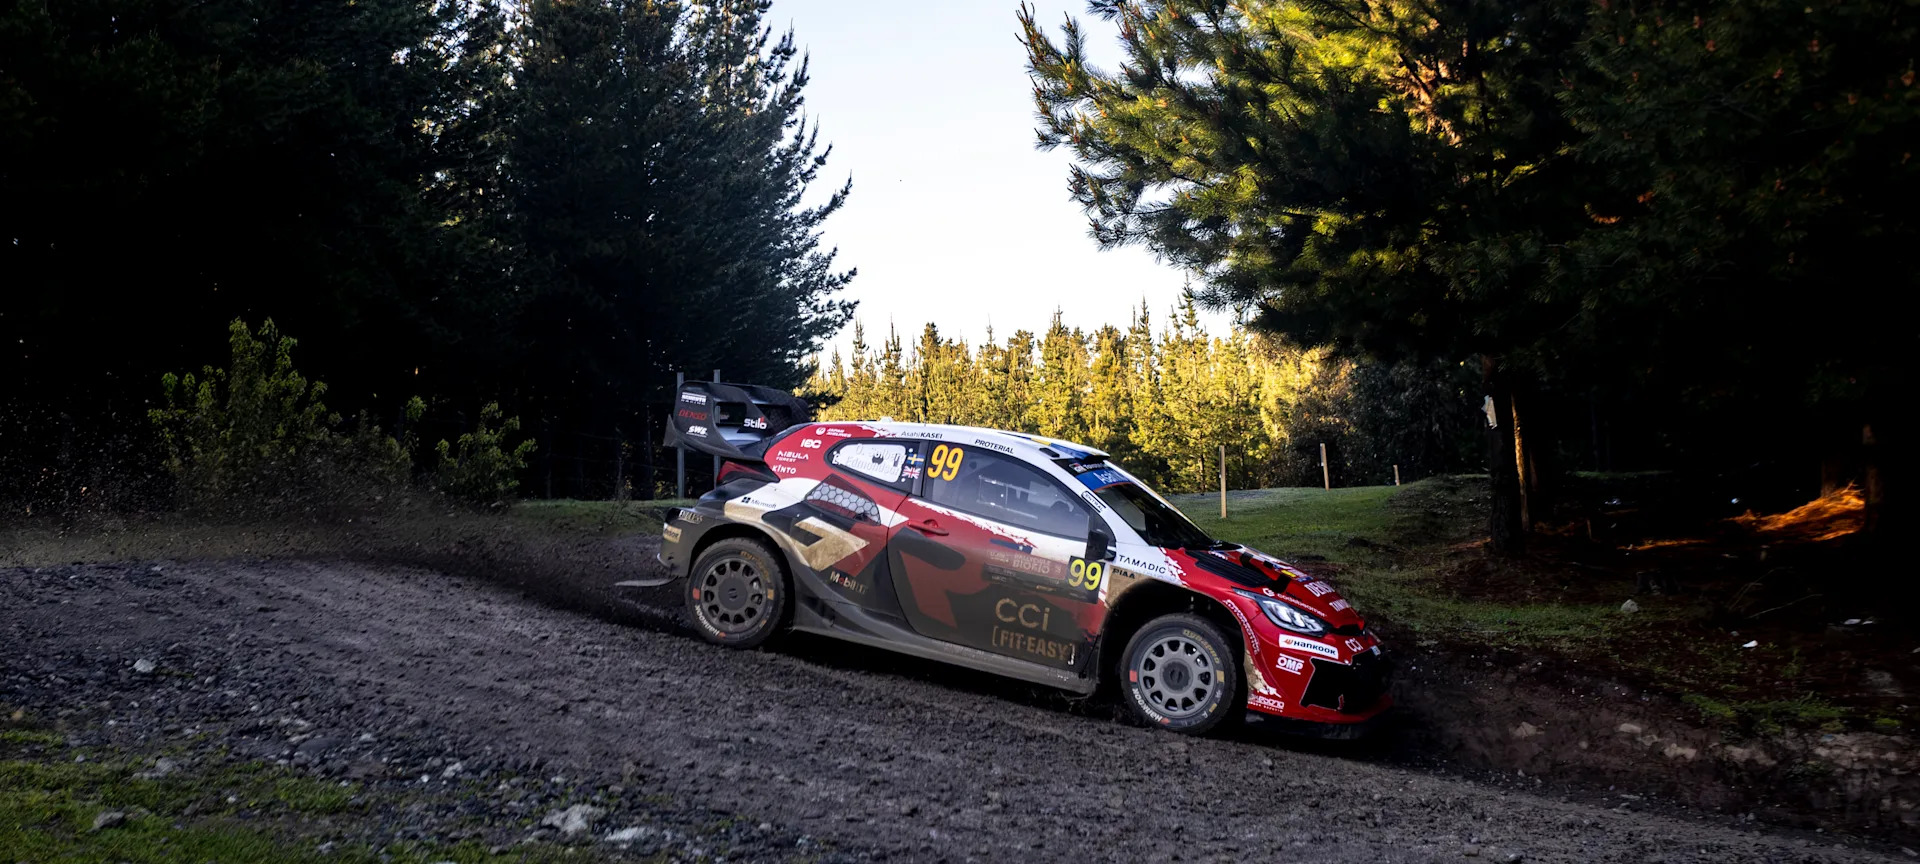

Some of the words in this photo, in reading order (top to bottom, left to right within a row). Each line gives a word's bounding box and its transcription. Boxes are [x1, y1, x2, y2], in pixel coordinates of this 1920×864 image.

[679, 409, 707, 420] DENSO
[901, 431, 943, 439] AsahiKASEI
[974, 438, 1014, 454] PROTERIAL
[927, 444, 964, 481] 99
[751, 499, 777, 509] Microsoft
[1119, 554, 1166, 574] TAMADIC
[1068, 558, 1102, 591] 99
[1112, 568, 1136, 579] PIAA
[1277, 657, 1304, 671] OMP
